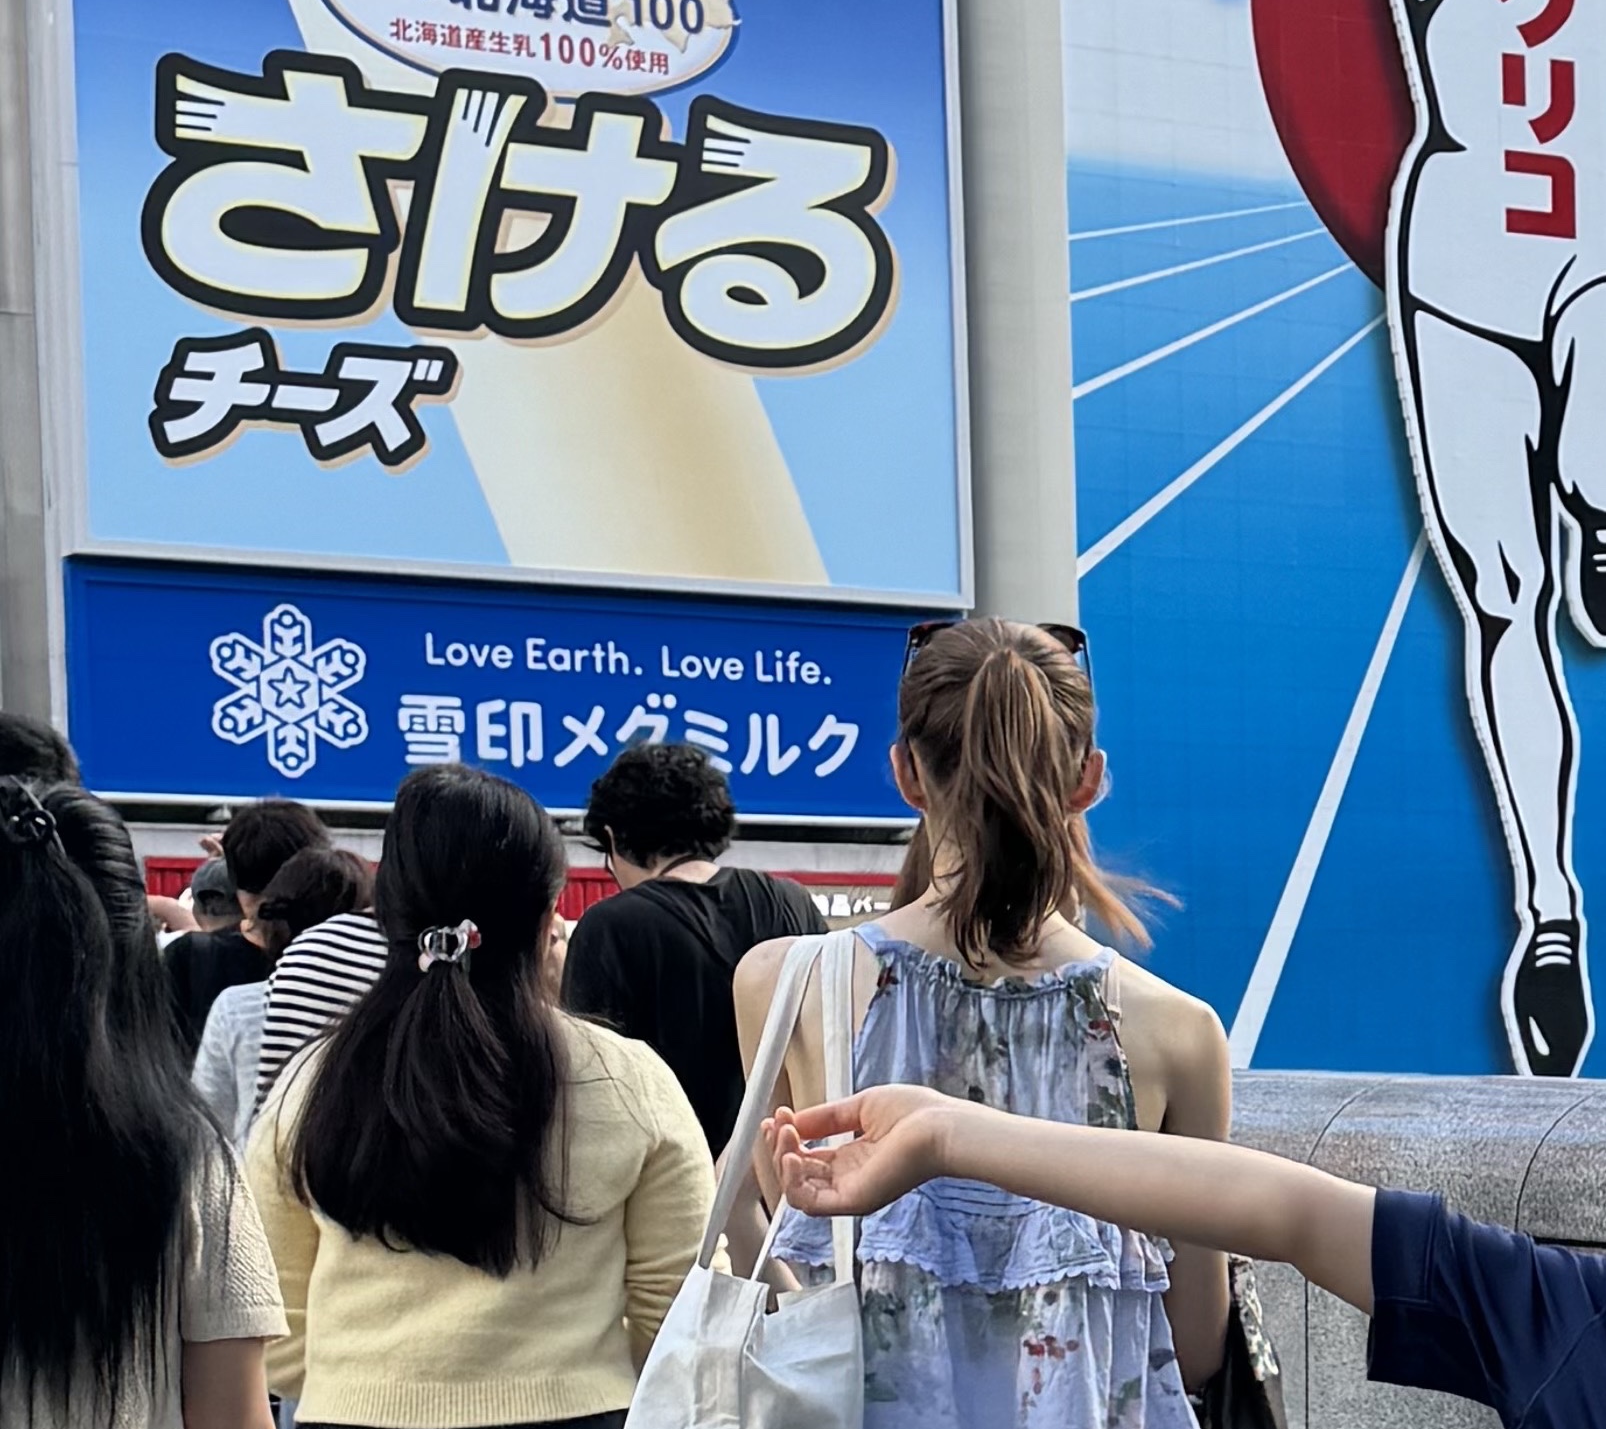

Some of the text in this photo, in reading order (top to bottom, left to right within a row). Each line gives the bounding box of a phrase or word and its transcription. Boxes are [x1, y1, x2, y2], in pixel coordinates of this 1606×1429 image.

[389, 17, 671, 76] 北海道産生乳100%使用
[150, 56, 888, 358] さける
[154, 332, 452, 462] チーズ
[425, 632, 833, 686] Love Earth. Love Life.
